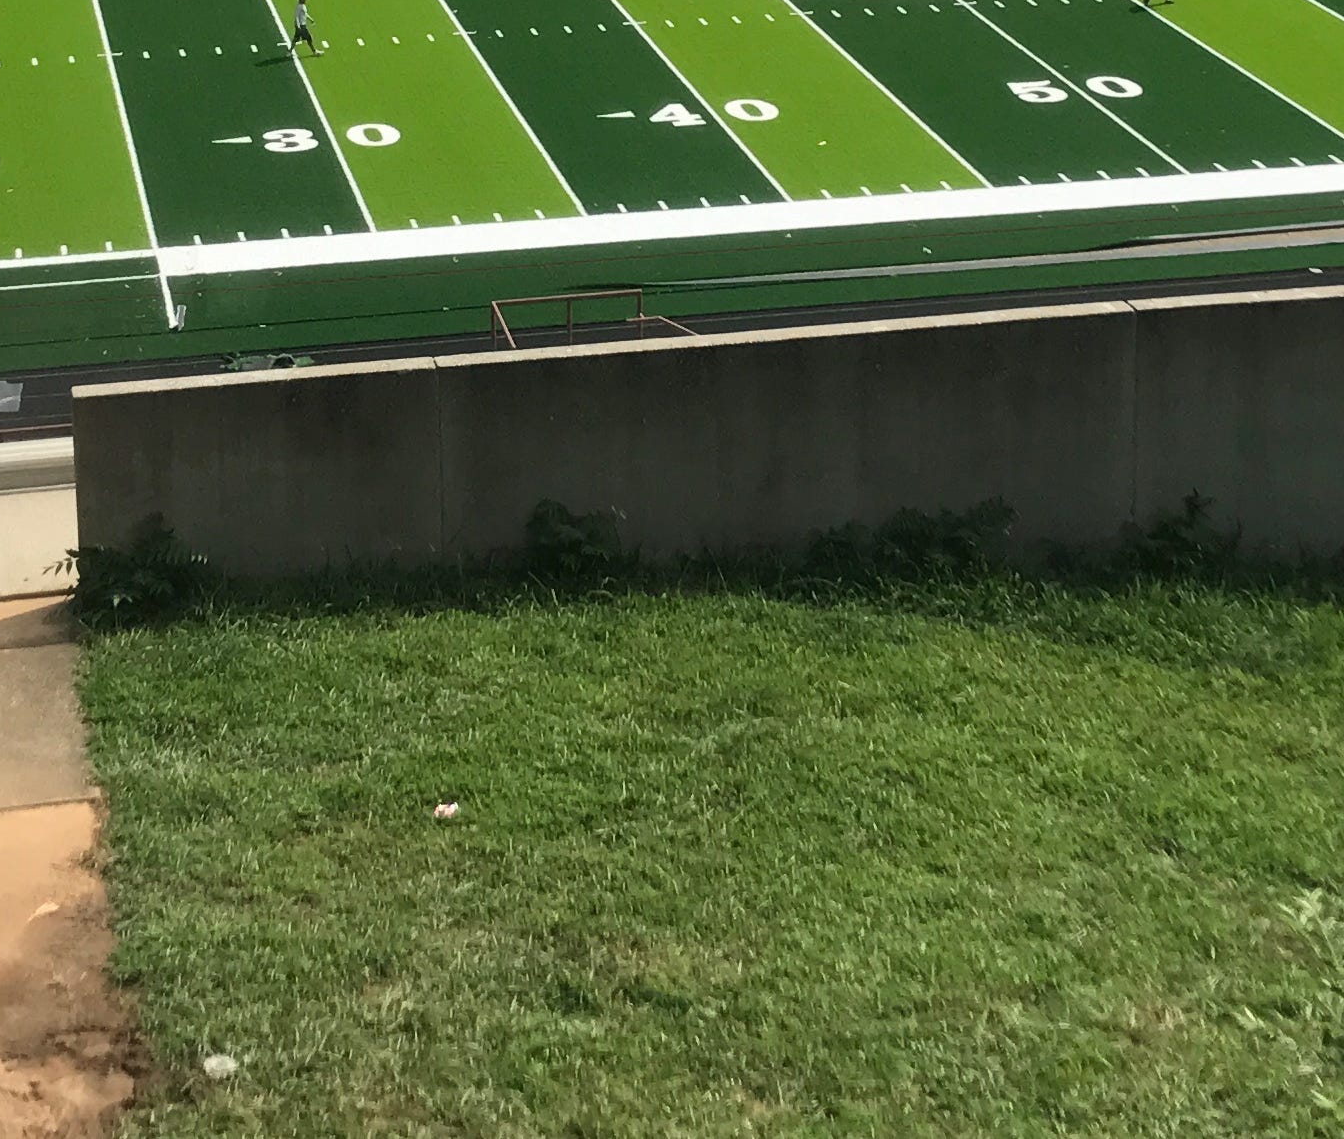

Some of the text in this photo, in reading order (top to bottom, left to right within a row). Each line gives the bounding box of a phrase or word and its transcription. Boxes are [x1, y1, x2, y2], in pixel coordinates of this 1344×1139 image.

[1007, 76, 1143, 104] 50
[650, 99, 779, 127] 40
[262, 123, 401, 153] 30
